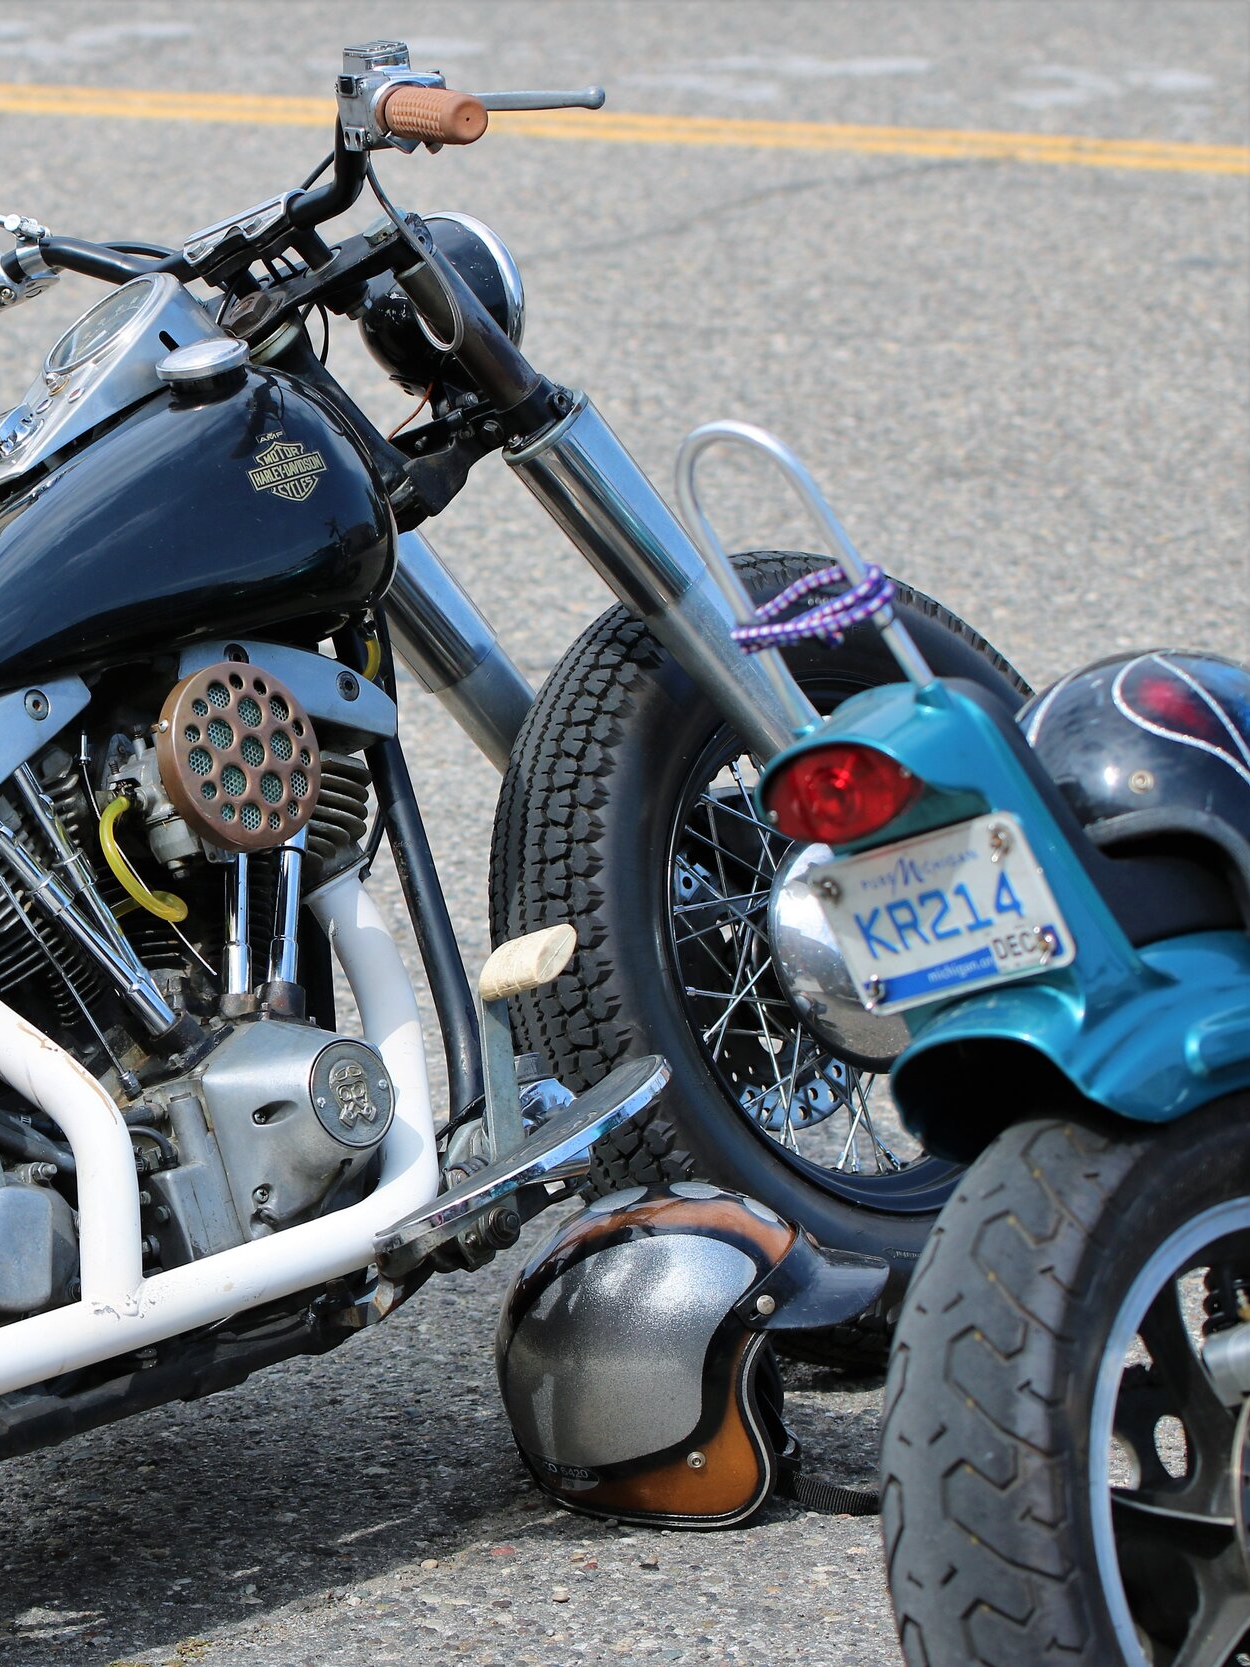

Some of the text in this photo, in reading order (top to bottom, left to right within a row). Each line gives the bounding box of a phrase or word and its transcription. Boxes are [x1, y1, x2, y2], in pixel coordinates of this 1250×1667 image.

[263, 445, 300, 465] MOTOR
[253, 455, 323, 486] HARLEY-DAVIDSON
[278, 476, 313, 498] CYCLES
[854, 870, 1024, 959] KR214
[992, 932, 1037, 960] DEC
[927, 954, 995, 983] michigan.or
